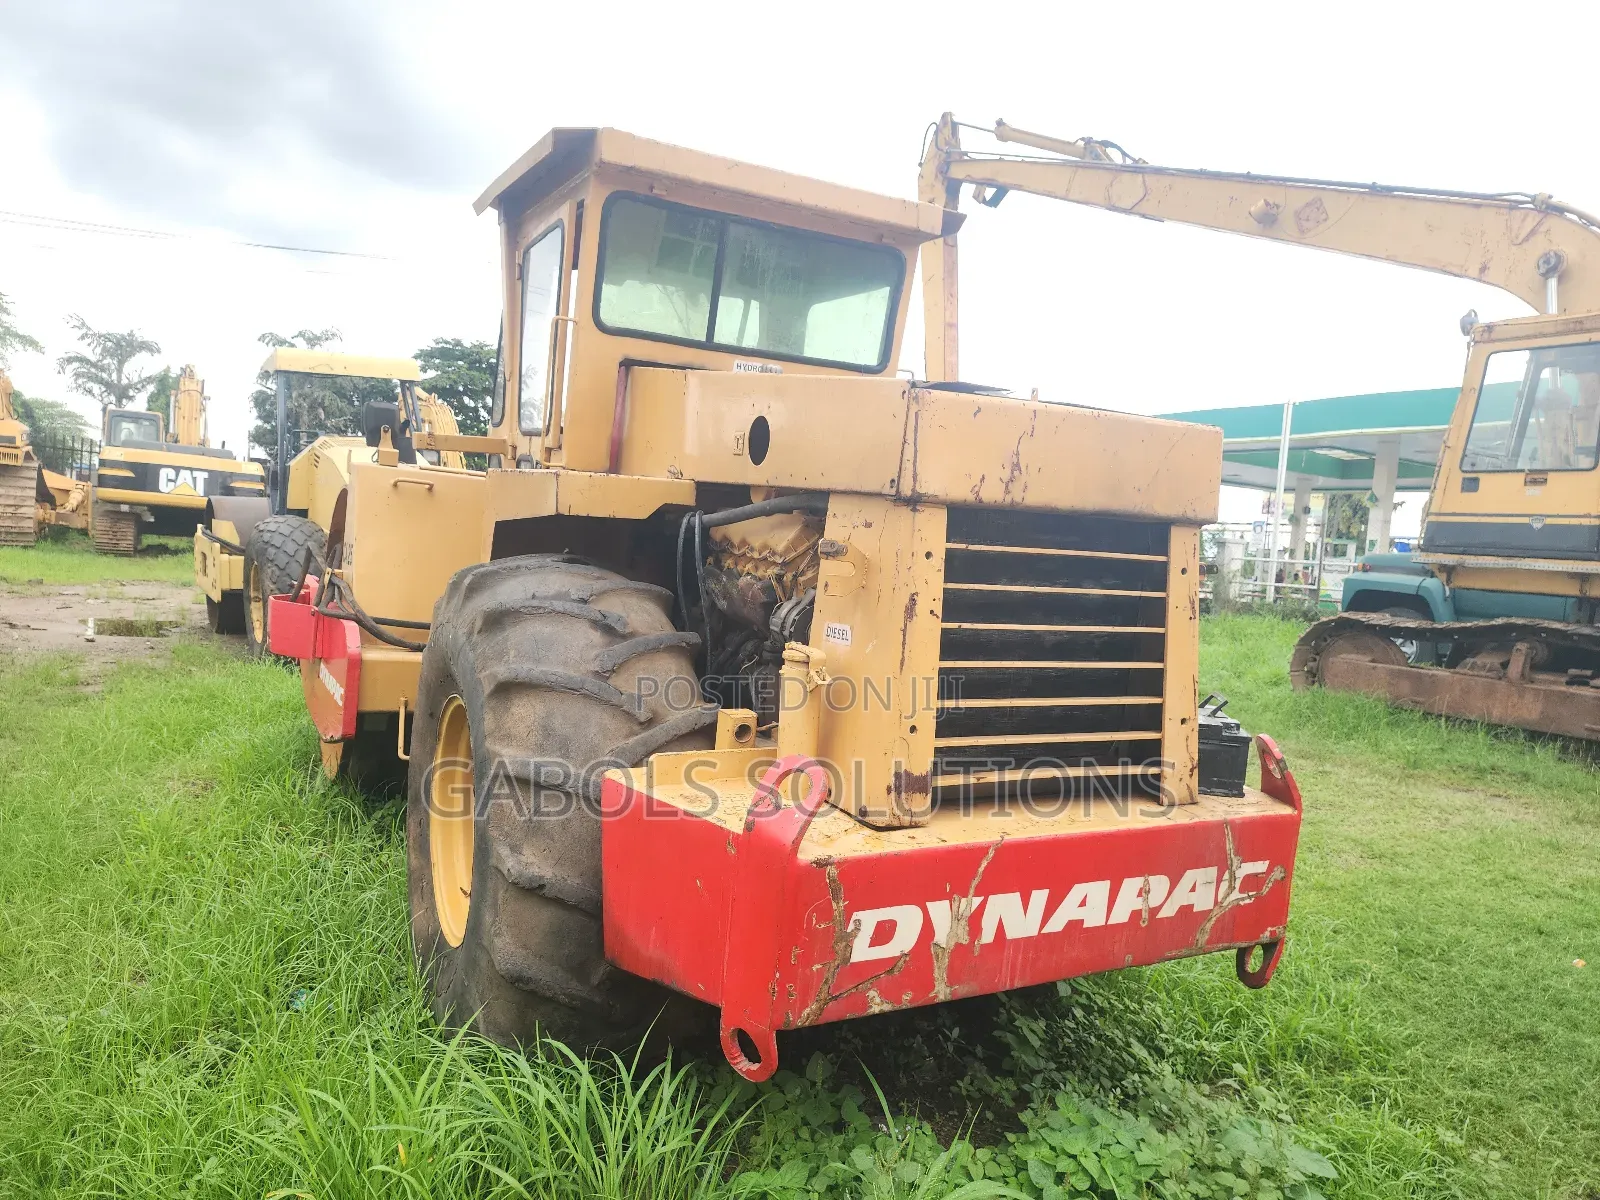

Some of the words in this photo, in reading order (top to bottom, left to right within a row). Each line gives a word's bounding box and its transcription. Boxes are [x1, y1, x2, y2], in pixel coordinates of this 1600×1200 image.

[158, 467, 209, 496] CAT
[825, 626, 849, 642] DIESEL
[849, 860, 1270, 963] DYNAPAC
